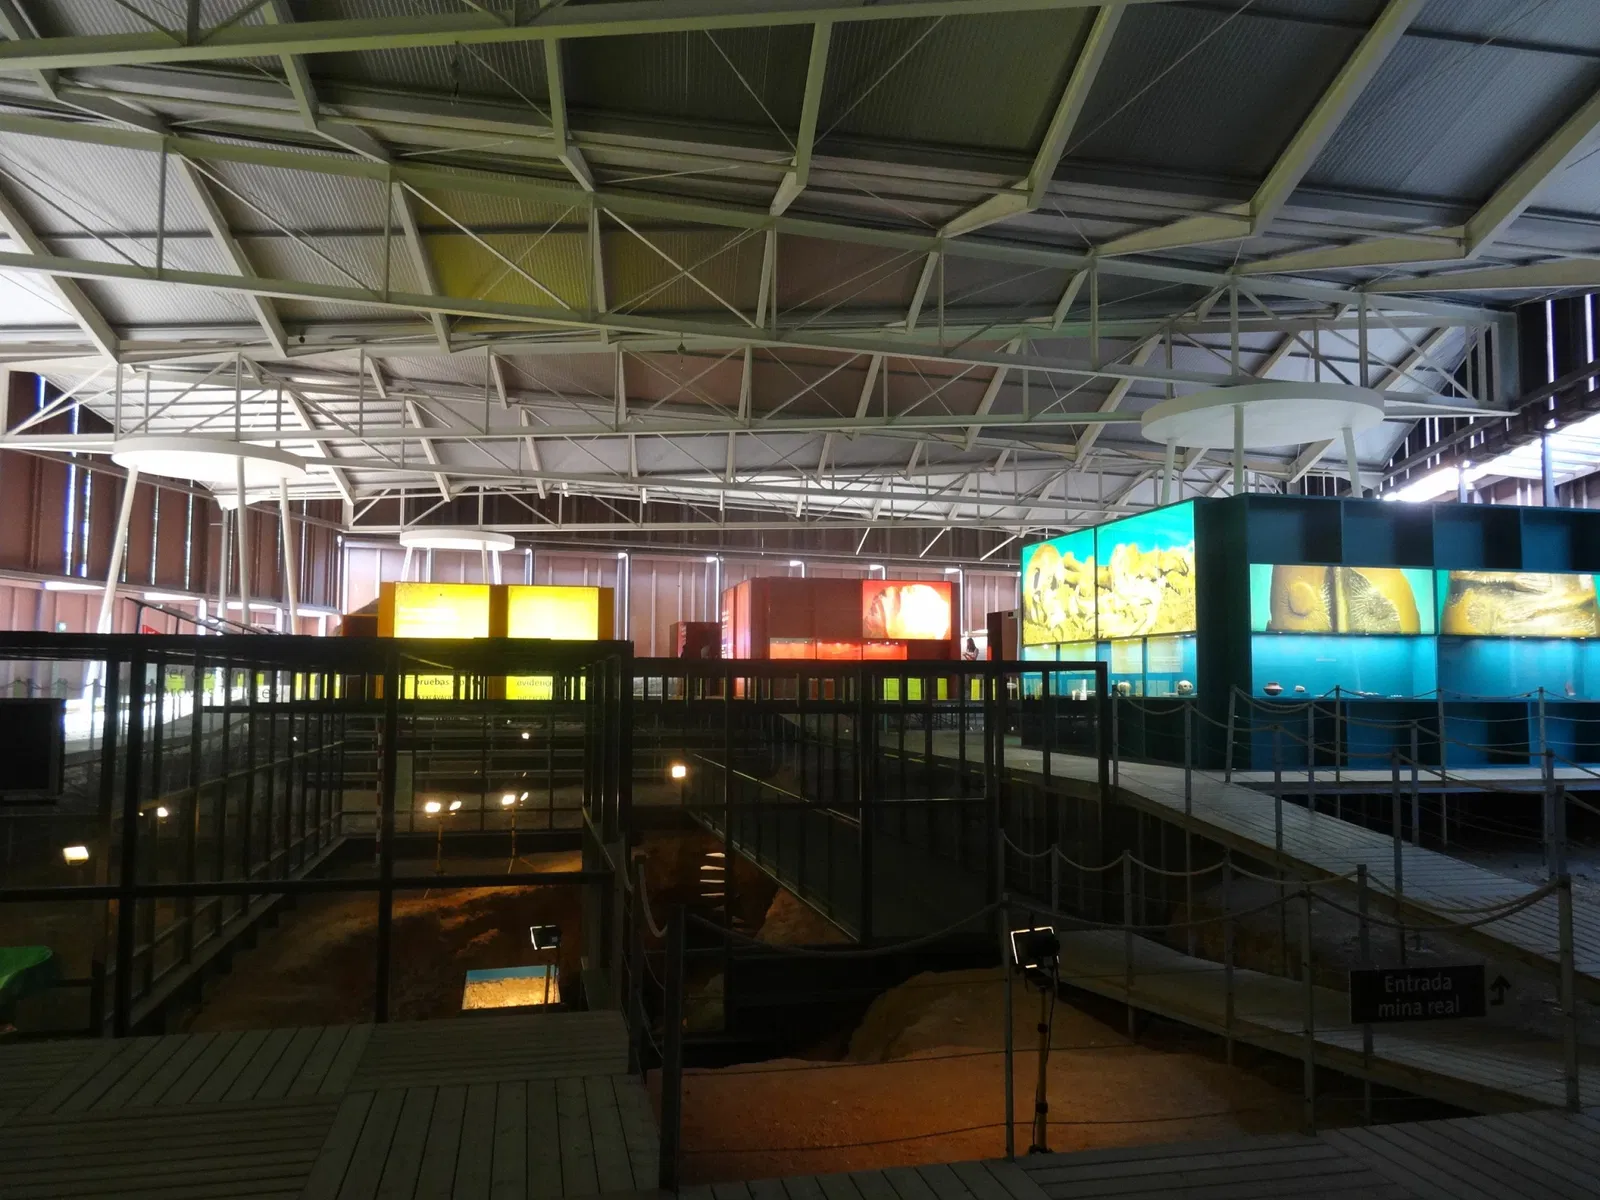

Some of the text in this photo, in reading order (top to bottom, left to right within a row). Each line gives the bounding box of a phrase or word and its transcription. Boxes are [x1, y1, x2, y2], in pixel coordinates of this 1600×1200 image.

[1384, 972, 1452, 993] Entrada
[1378, 993, 1460, 1017] mina real
